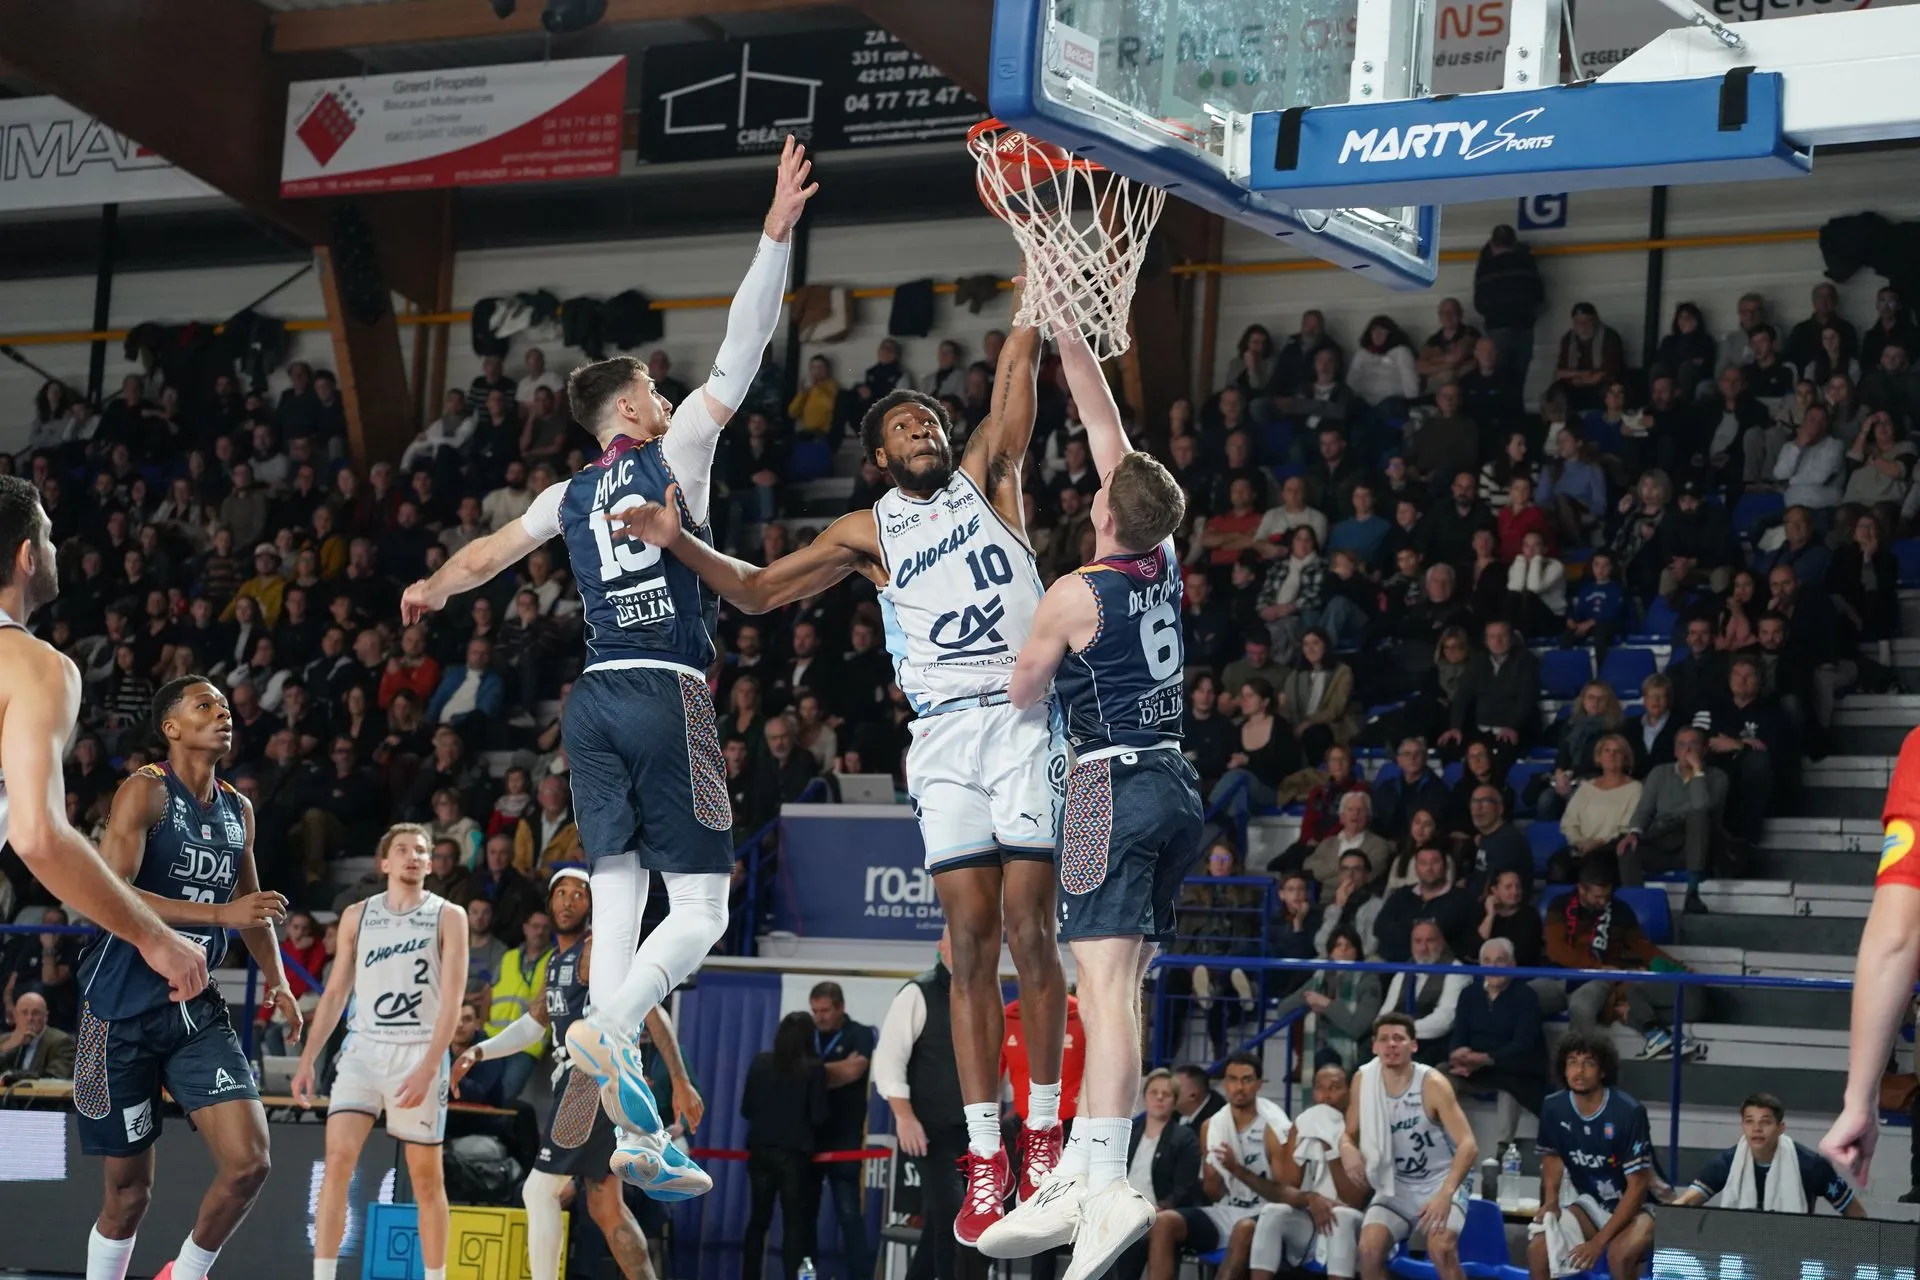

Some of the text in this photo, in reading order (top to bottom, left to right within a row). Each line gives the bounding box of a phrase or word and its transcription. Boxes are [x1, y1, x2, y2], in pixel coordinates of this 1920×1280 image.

[851, 50, 879, 66] 331
[884, 50, 909, 62] rue
[1433, 46, 1503, 67] éussir
[857, 66, 905, 84] 42120
[845, 93, 870, 112] 04
[875, 91, 900, 110] 77
[904, 88, 931, 107] 72
[935, 86, 962, 105] 47
[1338, 119, 1488, 164] MARTY
[1525, 194, 1561, 225] G
[886, 513, 920, 534] Loire
[589, 494, 661, 581] 13
[896, 513, 980, 589] CHORALE
[965, 544, 1013, 591] 10
[617, 597, 675, 621] DELIN
[1140, 601, 1180, 680] 6
[170, 843, 235, 888] JDA
[864, 904, 945, 918] AGGLOM
[365, 938, 431, 967] CHORALE
[414, 958, 429, 984] 2
[546, 988, 567, 1014] DA
[208, 1088, 219, 1096] Les
[1410, 1131, 1435, 1151] 31
